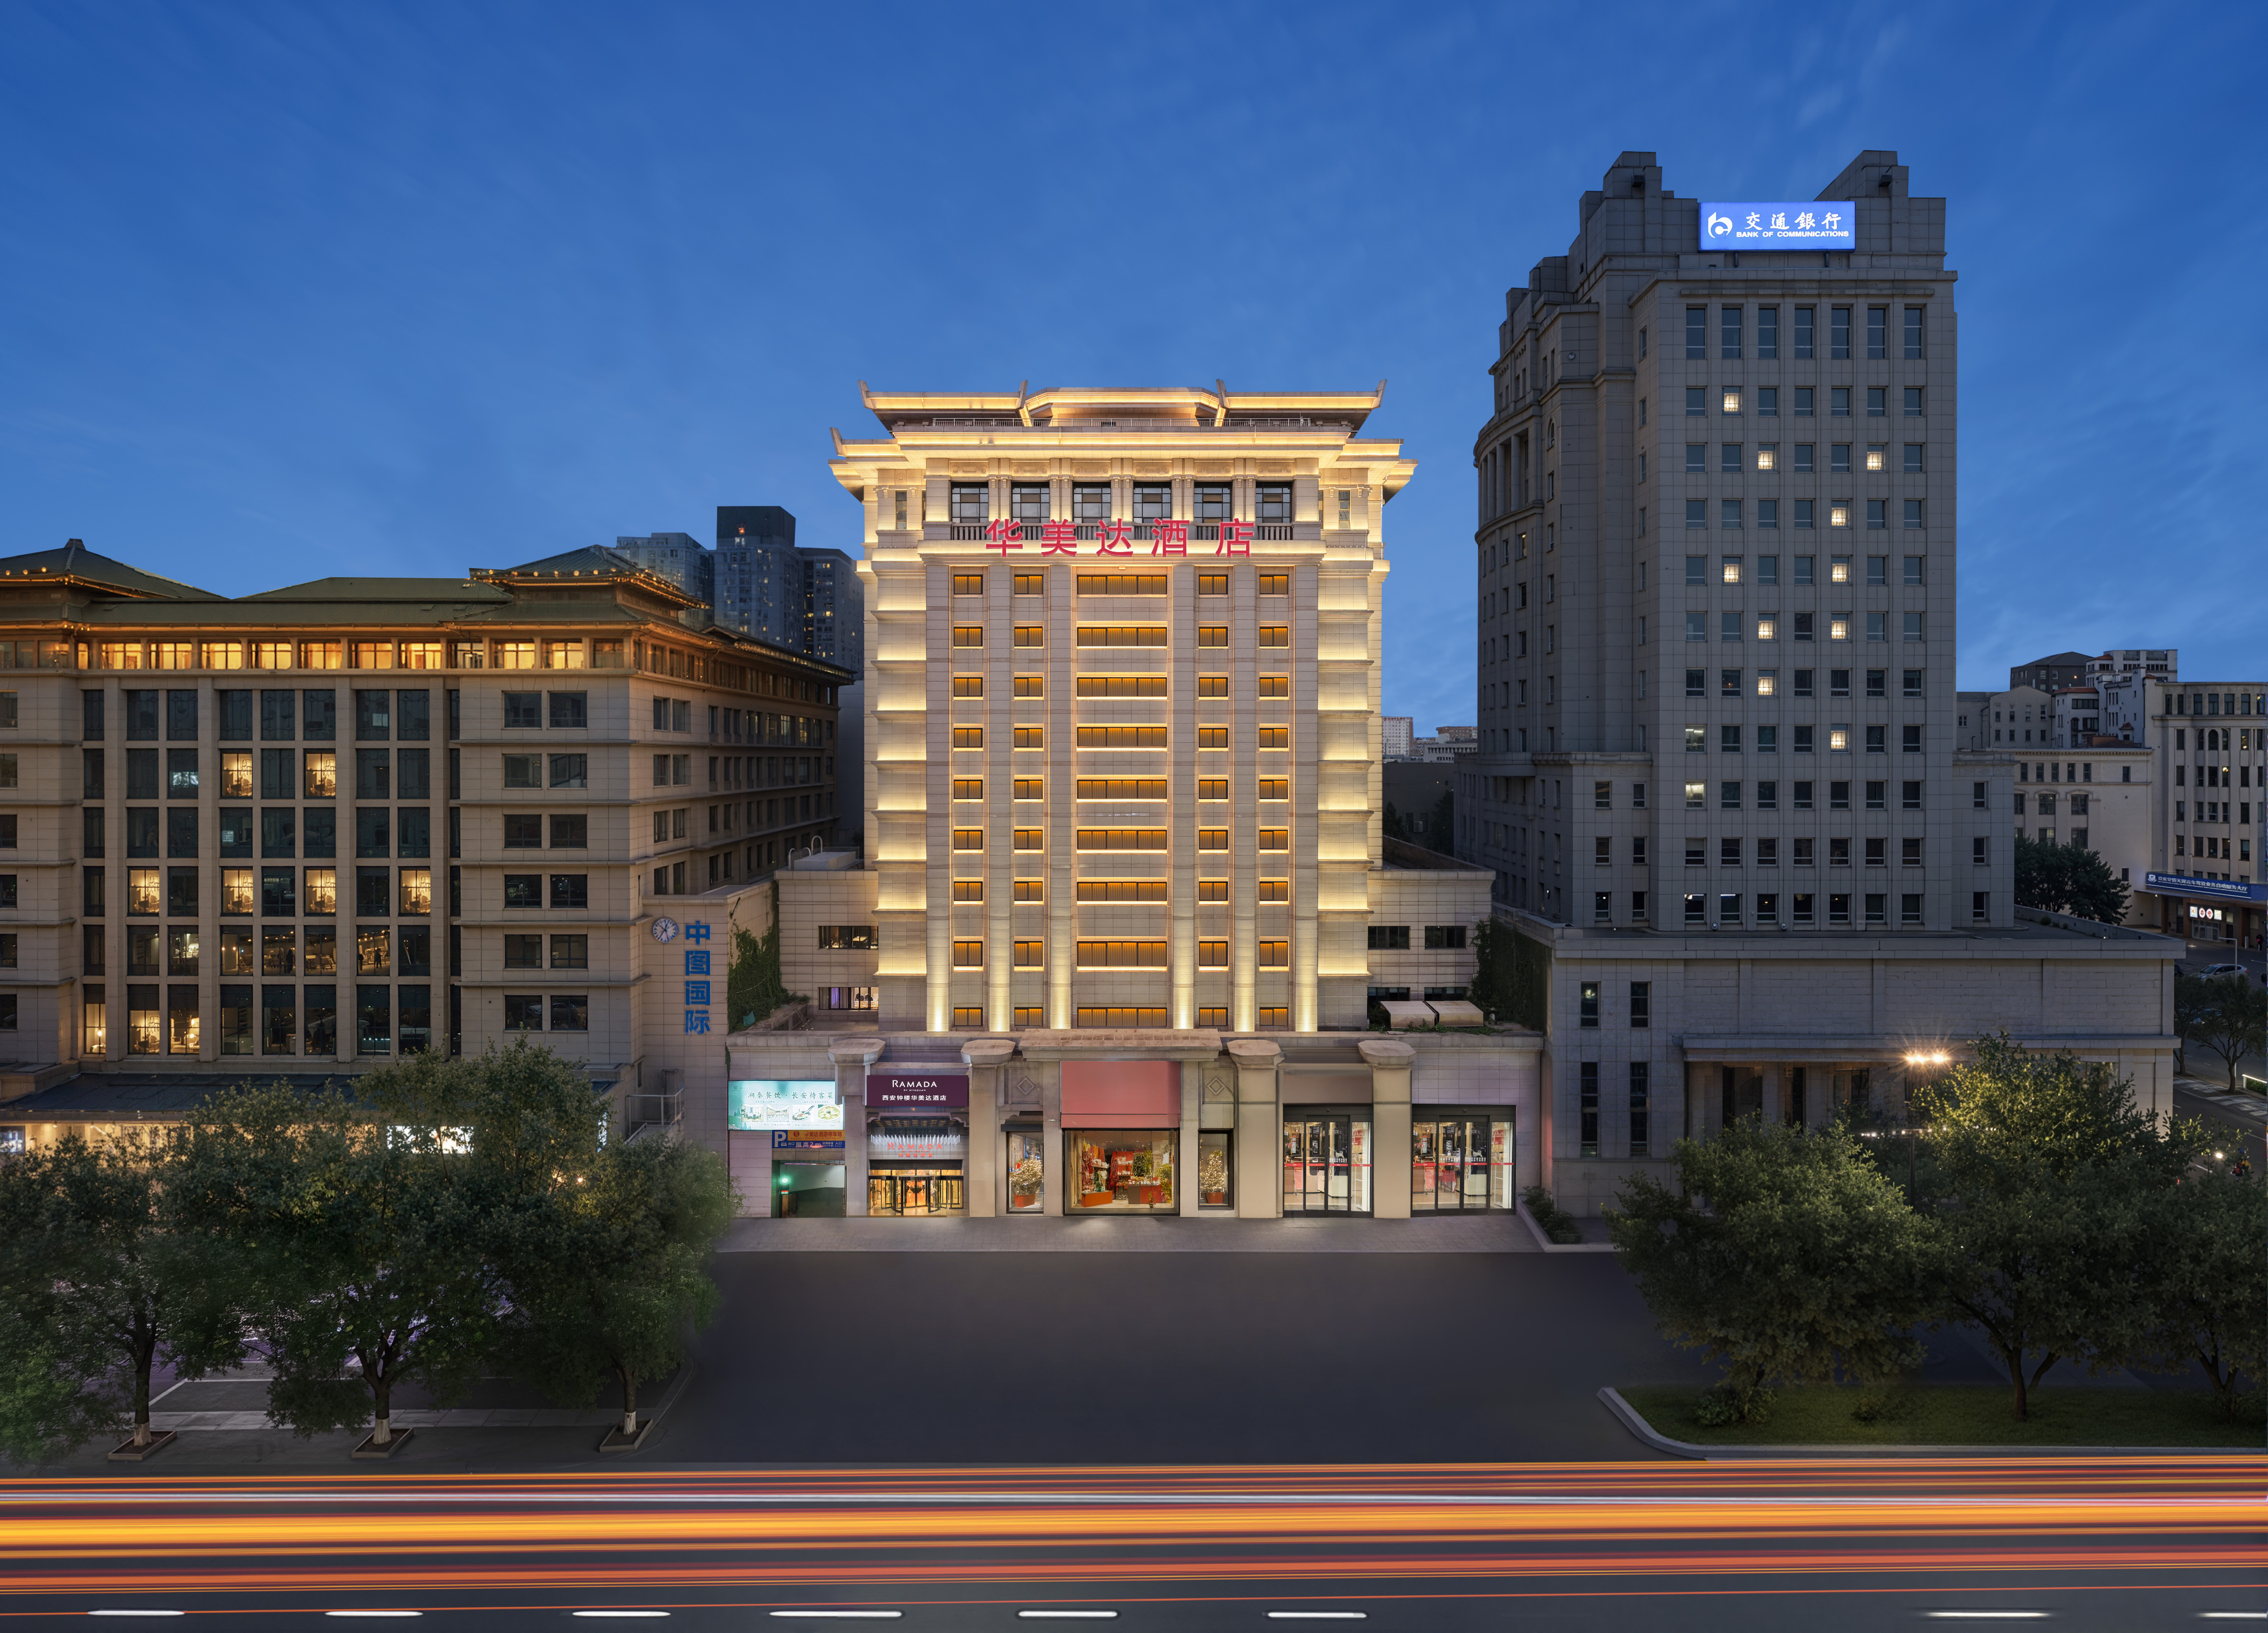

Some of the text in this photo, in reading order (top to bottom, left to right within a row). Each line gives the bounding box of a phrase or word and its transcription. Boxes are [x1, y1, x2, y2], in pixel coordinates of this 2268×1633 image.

[1744, 211, 1842, 230] 交通銀行
[985, 518, 1255, 558] 华美达酒店
[685, 920, 711, 1035] 中图国际
[774, 1131, 787, 1148] P
